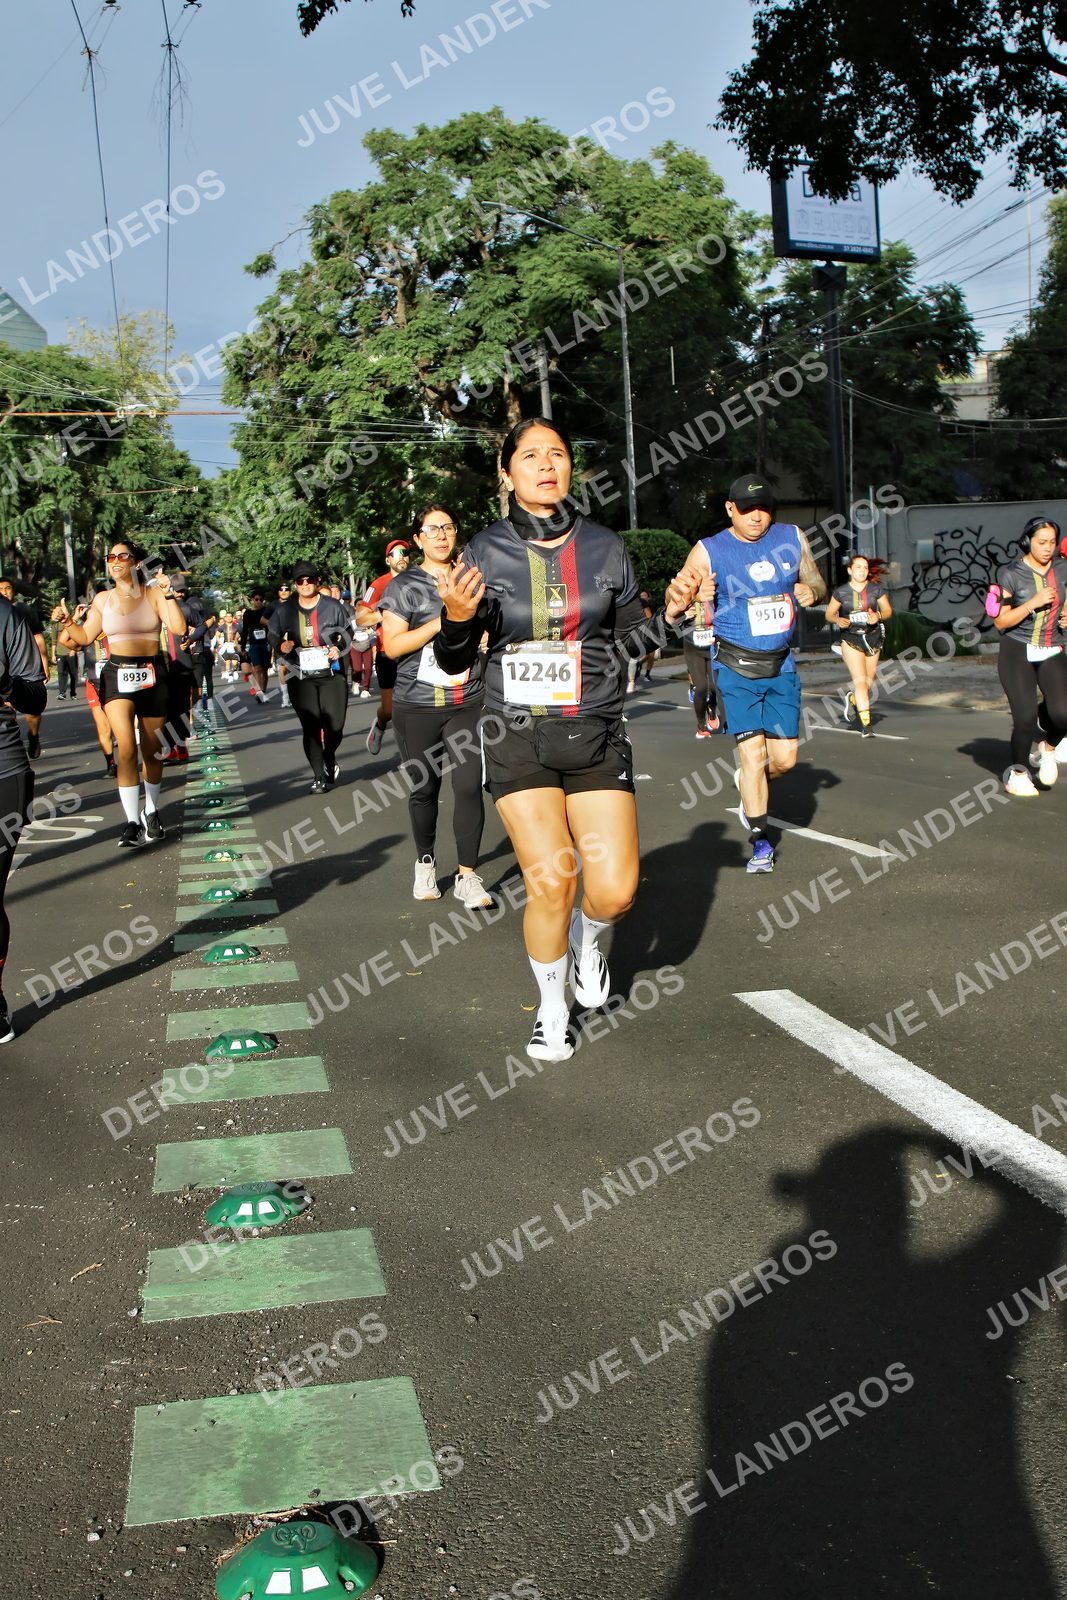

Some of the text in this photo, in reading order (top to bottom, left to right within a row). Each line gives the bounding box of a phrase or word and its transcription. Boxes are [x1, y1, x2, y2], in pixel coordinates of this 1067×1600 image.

[934, 525, 983, 543] TOY
[755, 607, 785, 622] 9516
[123, 672, 148, 682] 8939
[506, 661, 571, 682] 12246
